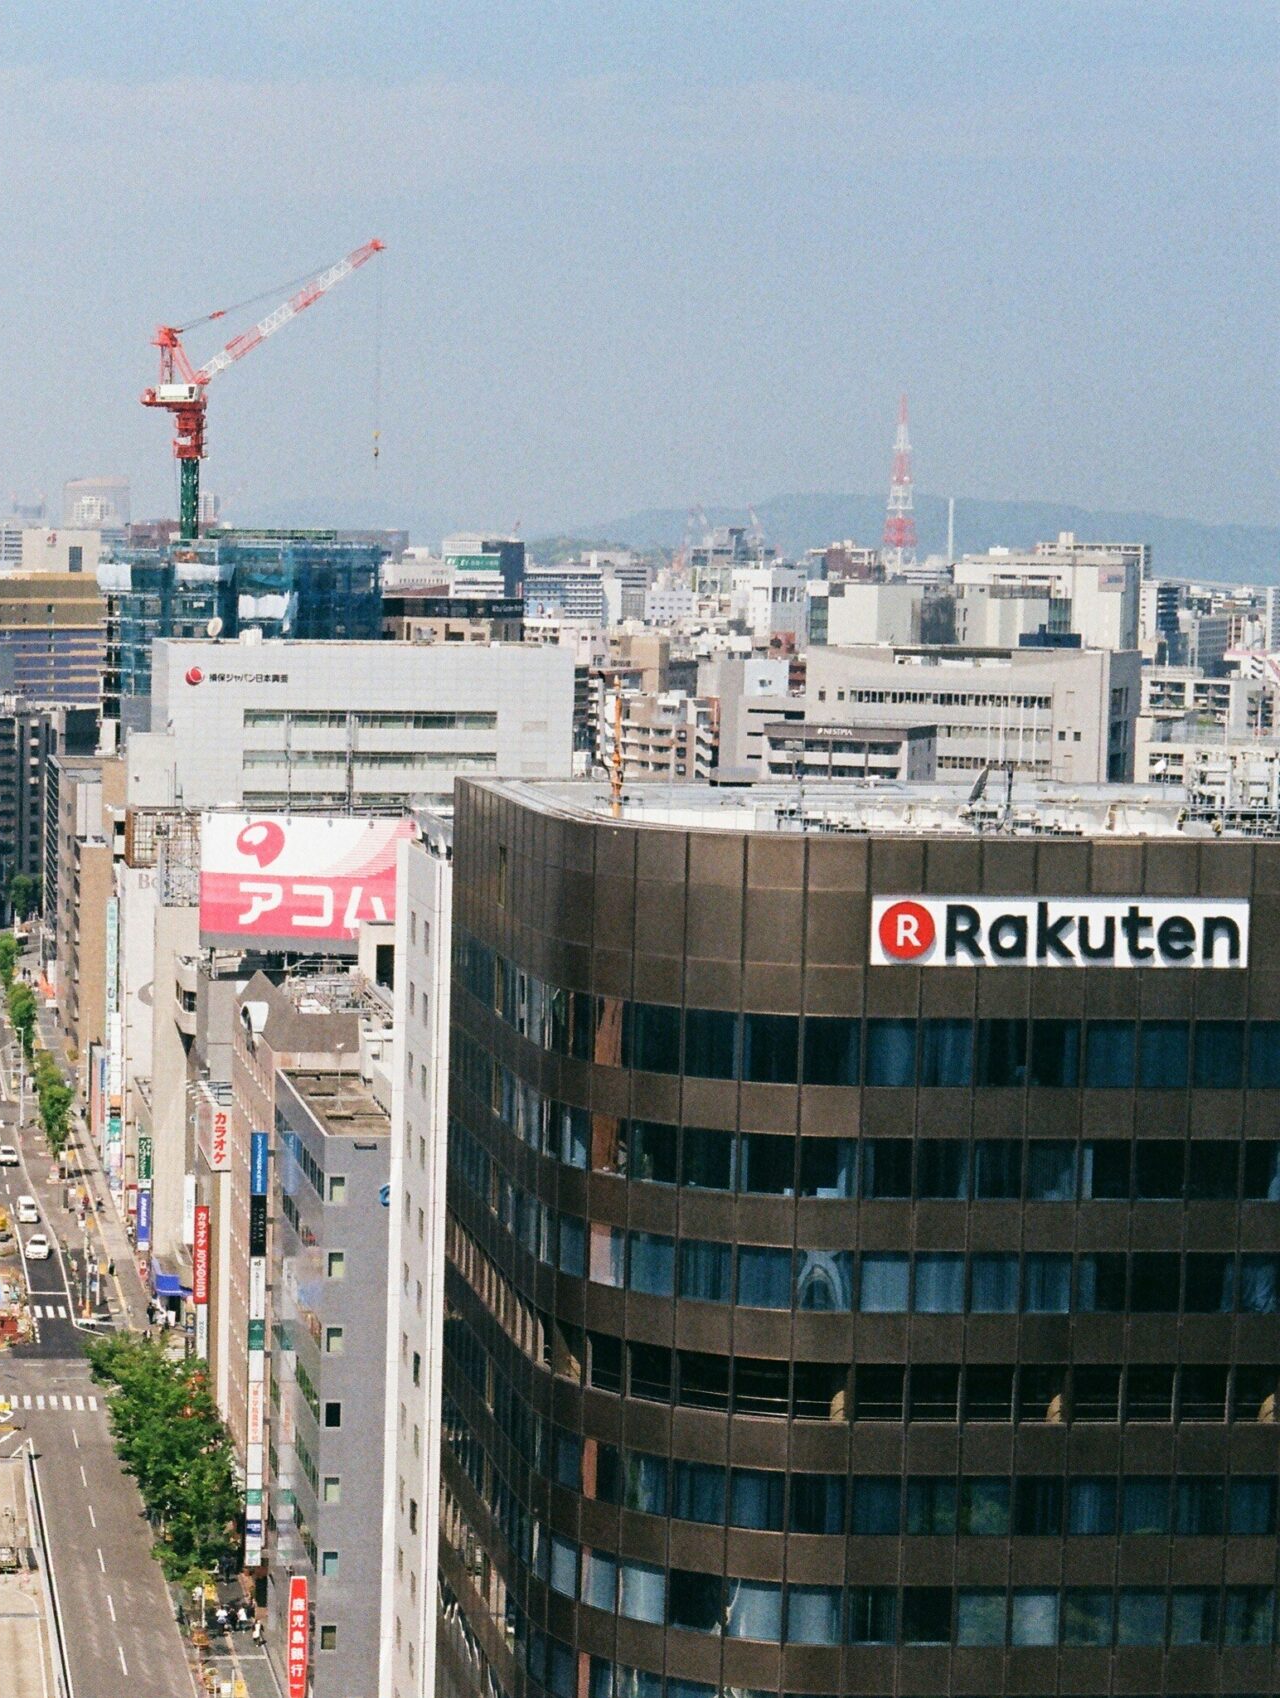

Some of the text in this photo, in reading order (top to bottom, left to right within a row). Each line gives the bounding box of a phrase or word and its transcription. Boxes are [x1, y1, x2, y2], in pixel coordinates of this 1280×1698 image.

[239, 881, 388, 929] アコム
[895, 901, 1241, 960] R Rakuten
[213, 1112, 227, 1164] カラオケ
[196, 1212, 207, 1298] カラオケ JOYSOUND
[291, 1598, 305, 1677] 鹿児島銀行
